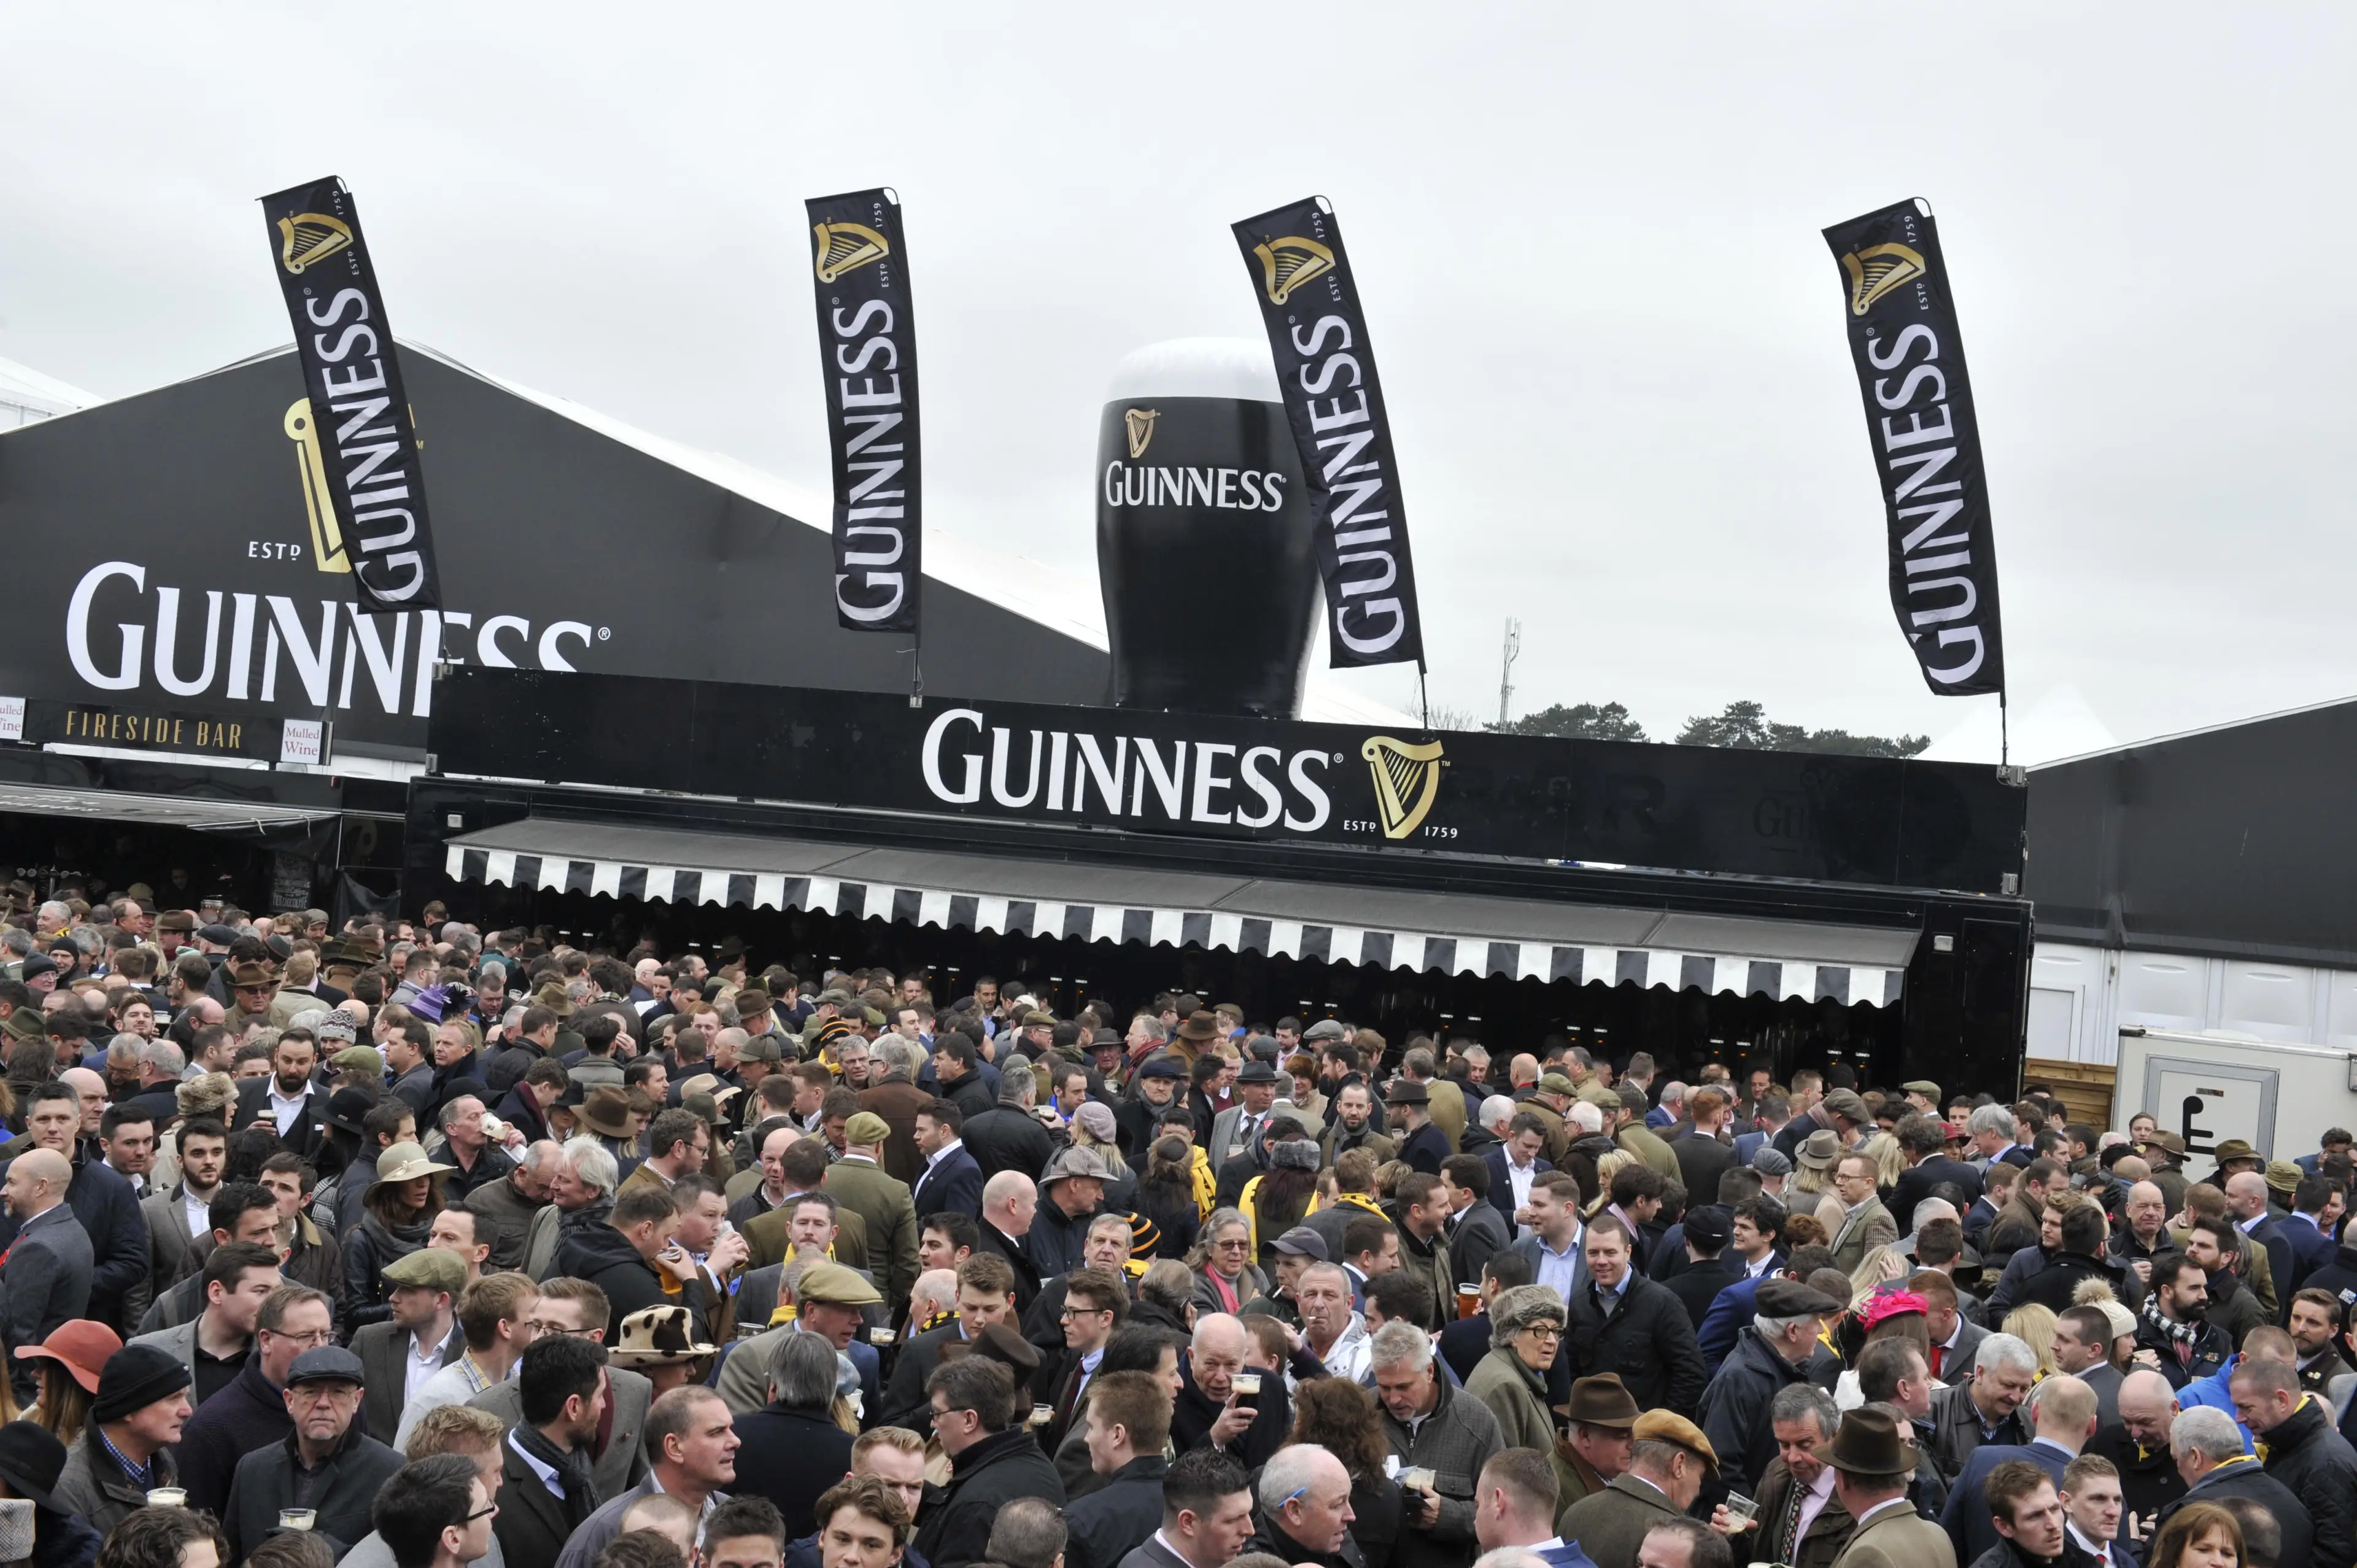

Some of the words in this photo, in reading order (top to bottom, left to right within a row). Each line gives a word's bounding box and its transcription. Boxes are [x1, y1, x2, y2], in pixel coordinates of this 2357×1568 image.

[332, 190, 344, 215] 1759
[873, 203, 883, 228] 1759
[1312, 212, 1325, 239] 1759
[1904, 215, 1917, 243] 1759
[307, 288, 424, 602] GUINNESS
[833, 299, 905, 622] GUINNESS
[1105, 460, 1283, 512] GUINNESS
[1291, 315, 1404, 654] GUINNESS
[1868, 324, 1984, 684] GUINNESS
[0, 705, 23, 716] ulled
[66, 711, 184, 745] FIRESIDE
[196, 720, 241, 749] BAR
[286, 727, 319, 739] Mulled
[285, 741, 318, 756] Wine
[922, 708, 1330, 832] GUINNESS
[1425, 826, 1458, 838] 1759
